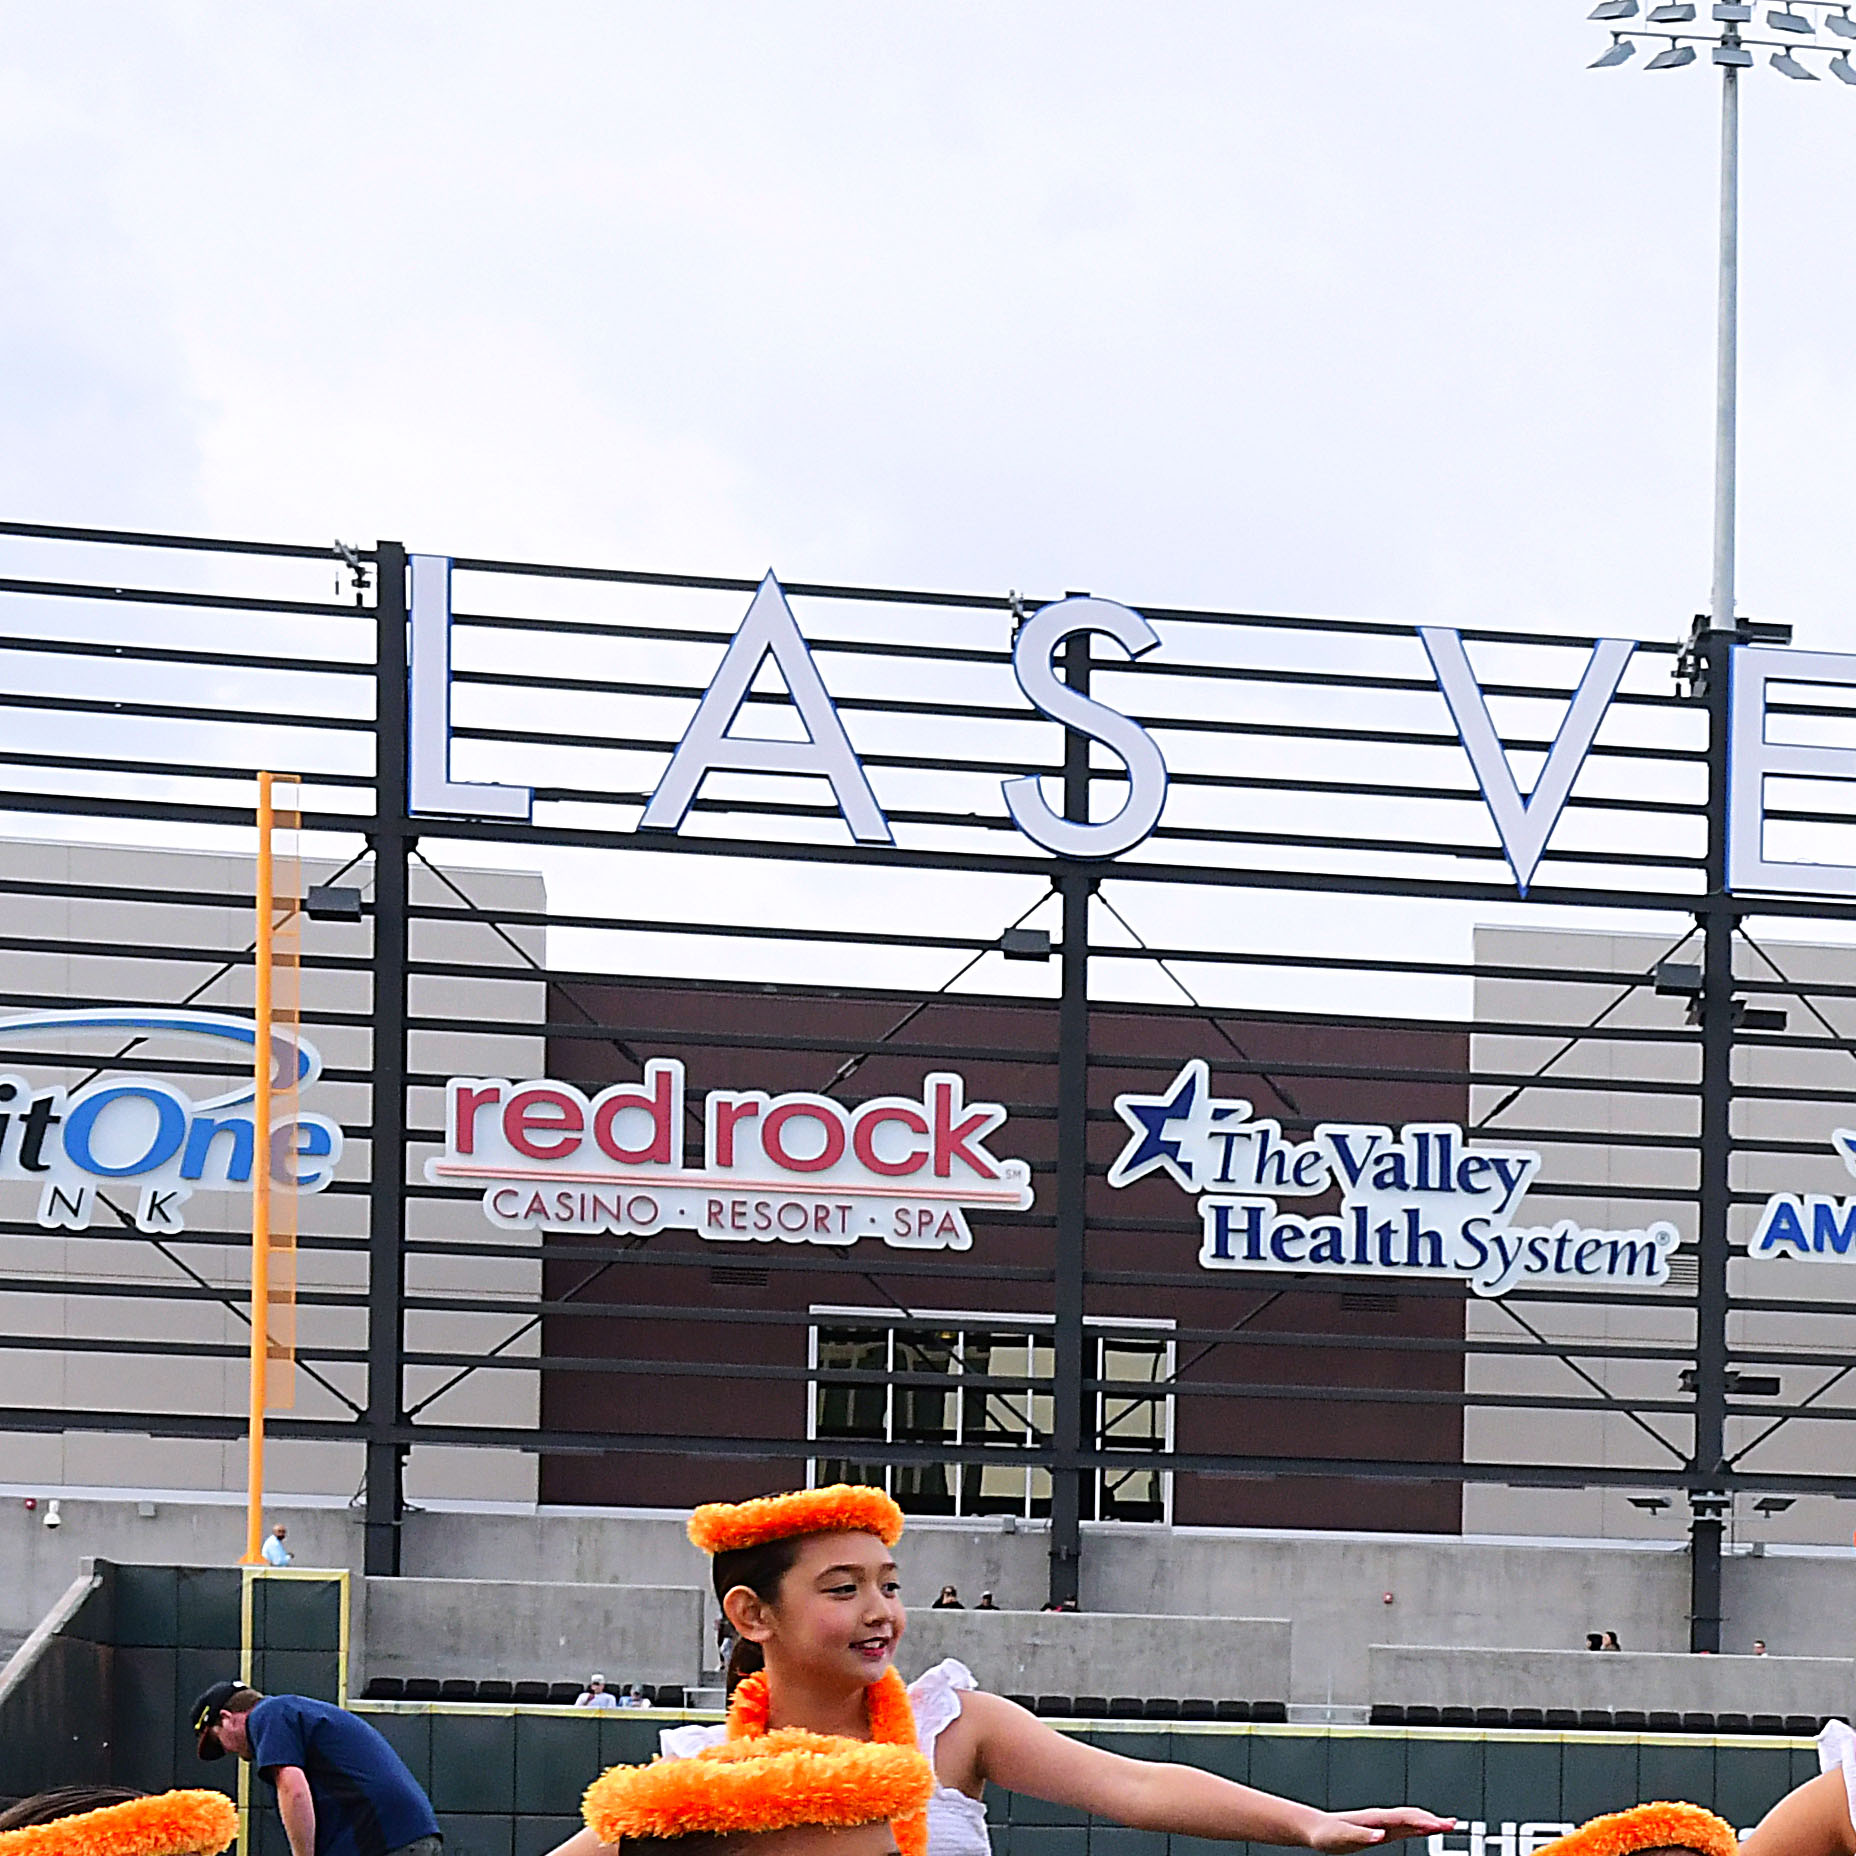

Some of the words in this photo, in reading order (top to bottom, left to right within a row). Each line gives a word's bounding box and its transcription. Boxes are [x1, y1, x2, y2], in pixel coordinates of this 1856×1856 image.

[408, 553, 1168, 861] LAS
[454, 1071, 672, 1165] red
[715, 1083, 1002, 1180] rock
[492, 1188, 659, 1227] CASINO
[706, 1199, 853, 1235] RESORT
[893, 1208, 962, 1240] SPA
[1208, 1128, 1325, 1186] The
[1325, 1132, 1531, 1214] Valley
[1208, 1204, 1448, 1270] Health
[1453, 1217, 1662, 1288] System
